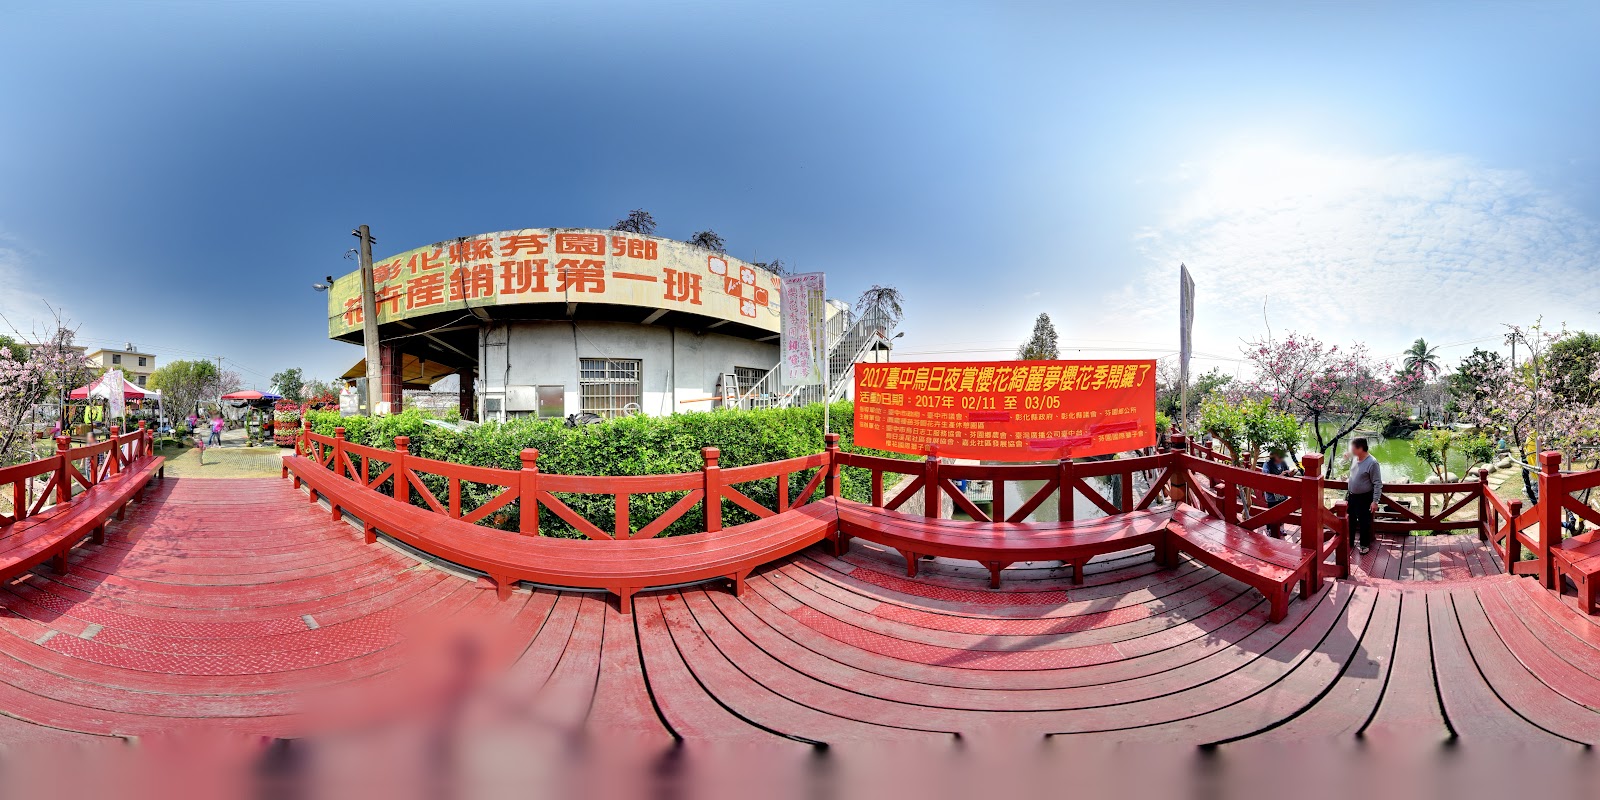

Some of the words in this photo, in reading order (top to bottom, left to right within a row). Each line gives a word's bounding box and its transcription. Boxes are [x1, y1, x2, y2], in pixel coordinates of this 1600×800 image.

[373, 233, 658, 284] 彰化縣芬園鄉
[344, 257, 703, 326] 花卉產銷班第一班
[860, 364, 1151, 393] 2017臺中烏日夜賞櫻花綺麗夢櫻花季開鑼了
[961, 396, 996, 410] 02/11
[1003, 396, 1017, 410] 至
[1025, 395, 1061, 410] 03/05
